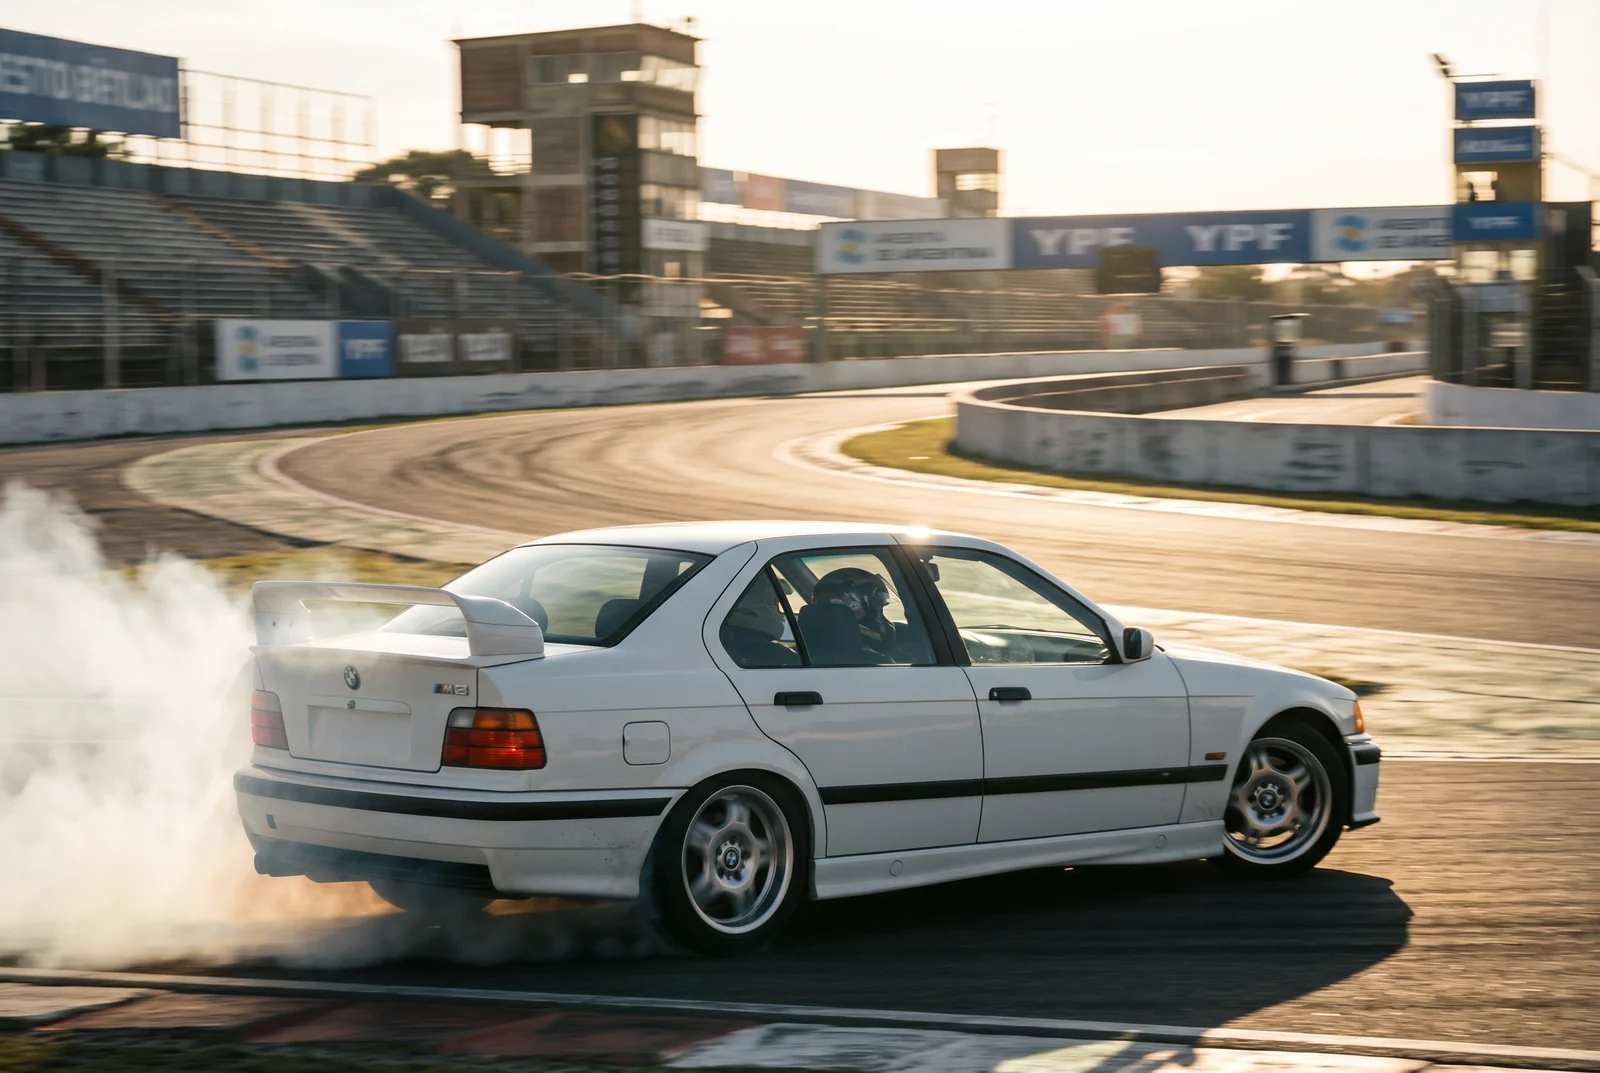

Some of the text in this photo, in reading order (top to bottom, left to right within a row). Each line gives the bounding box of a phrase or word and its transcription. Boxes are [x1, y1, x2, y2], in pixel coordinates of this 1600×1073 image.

[1028, 228, 1135, 255] YPF
[1181, 223, 1294, 251] YPF
[442, 684, 470, 696] M3
